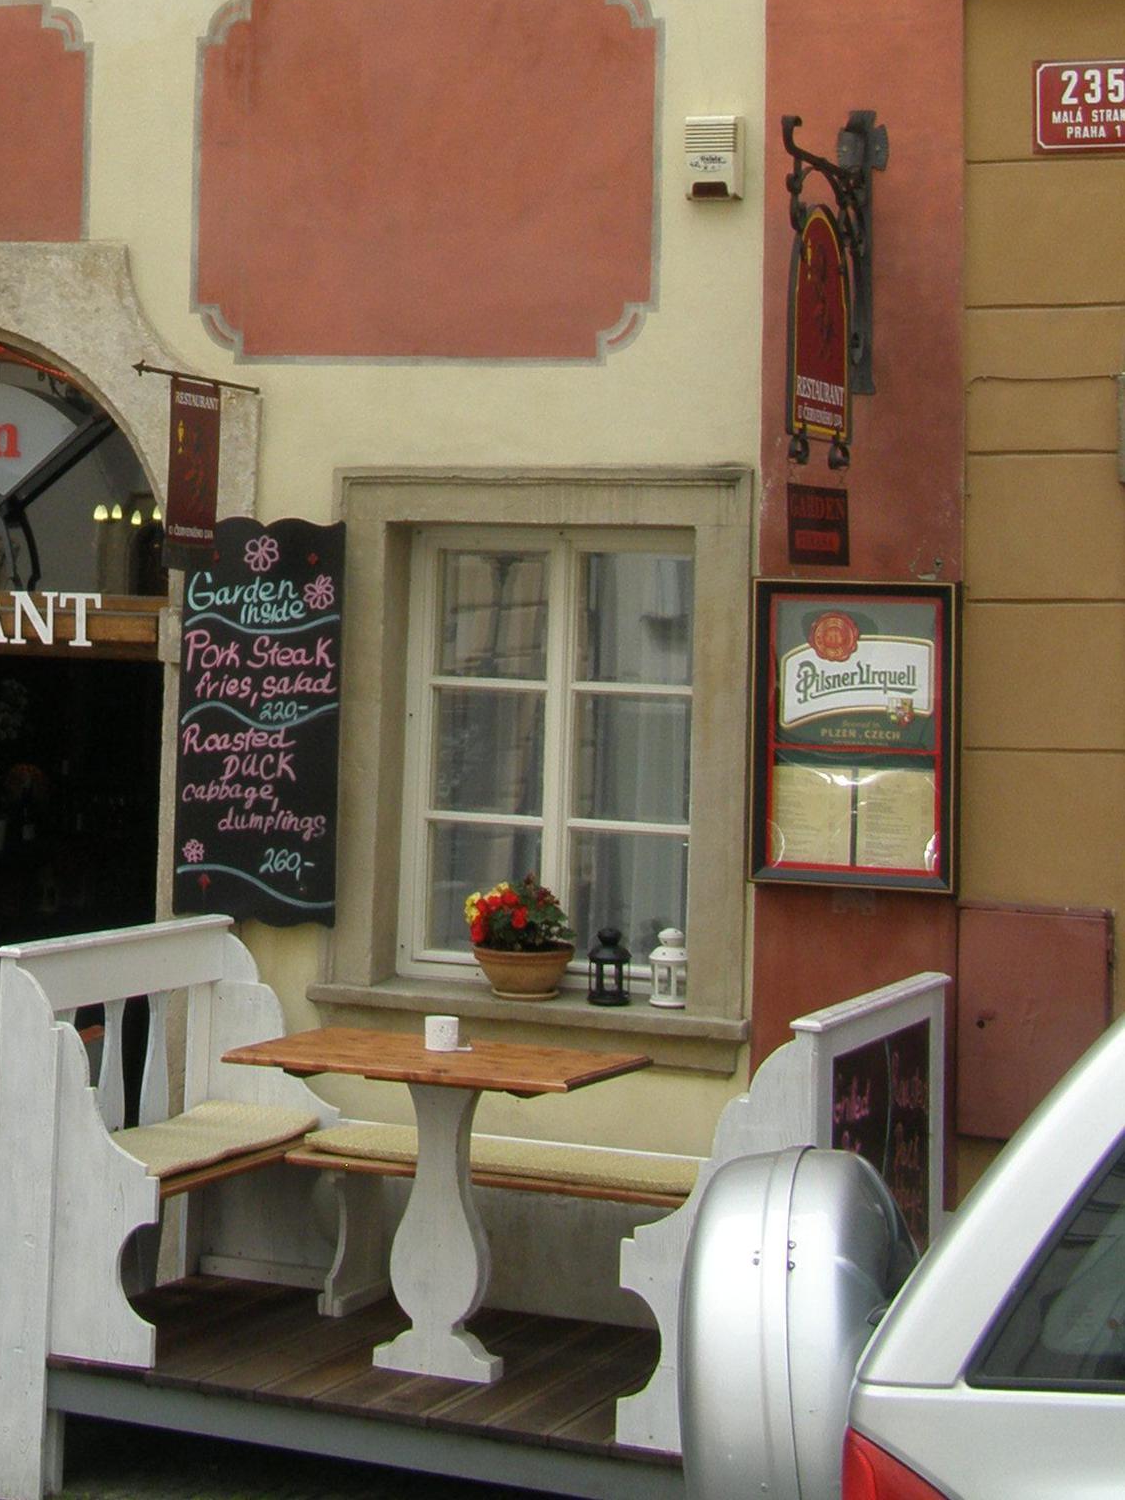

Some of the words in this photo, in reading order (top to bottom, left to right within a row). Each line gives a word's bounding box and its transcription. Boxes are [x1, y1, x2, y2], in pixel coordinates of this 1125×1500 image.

[1061, 68, 1125, 105] 235
[1052, 106, 1083, 124] MALÁ
[1091, 108, 1125, 122] STRAN
[1066, 125, 1106, 139] PRAHA
[1115, 125, 1121, 138] 1
[175, 391, 219, 411] RESTAURANT
[796, 374, 844, 407] RESTAURANT
[187, 571, 298, 611] Garden
[185, 629, 240, 672] Pork
[246, 634, 335, 669] Steak
[261, 670, 337, 699] salad
[795, 660, 857, 705] Pilsner
[856, 660, 916, 695] Urquell
[182, 723, 296, 756] Roasted
[218, 806, 327, 842] dumplings
